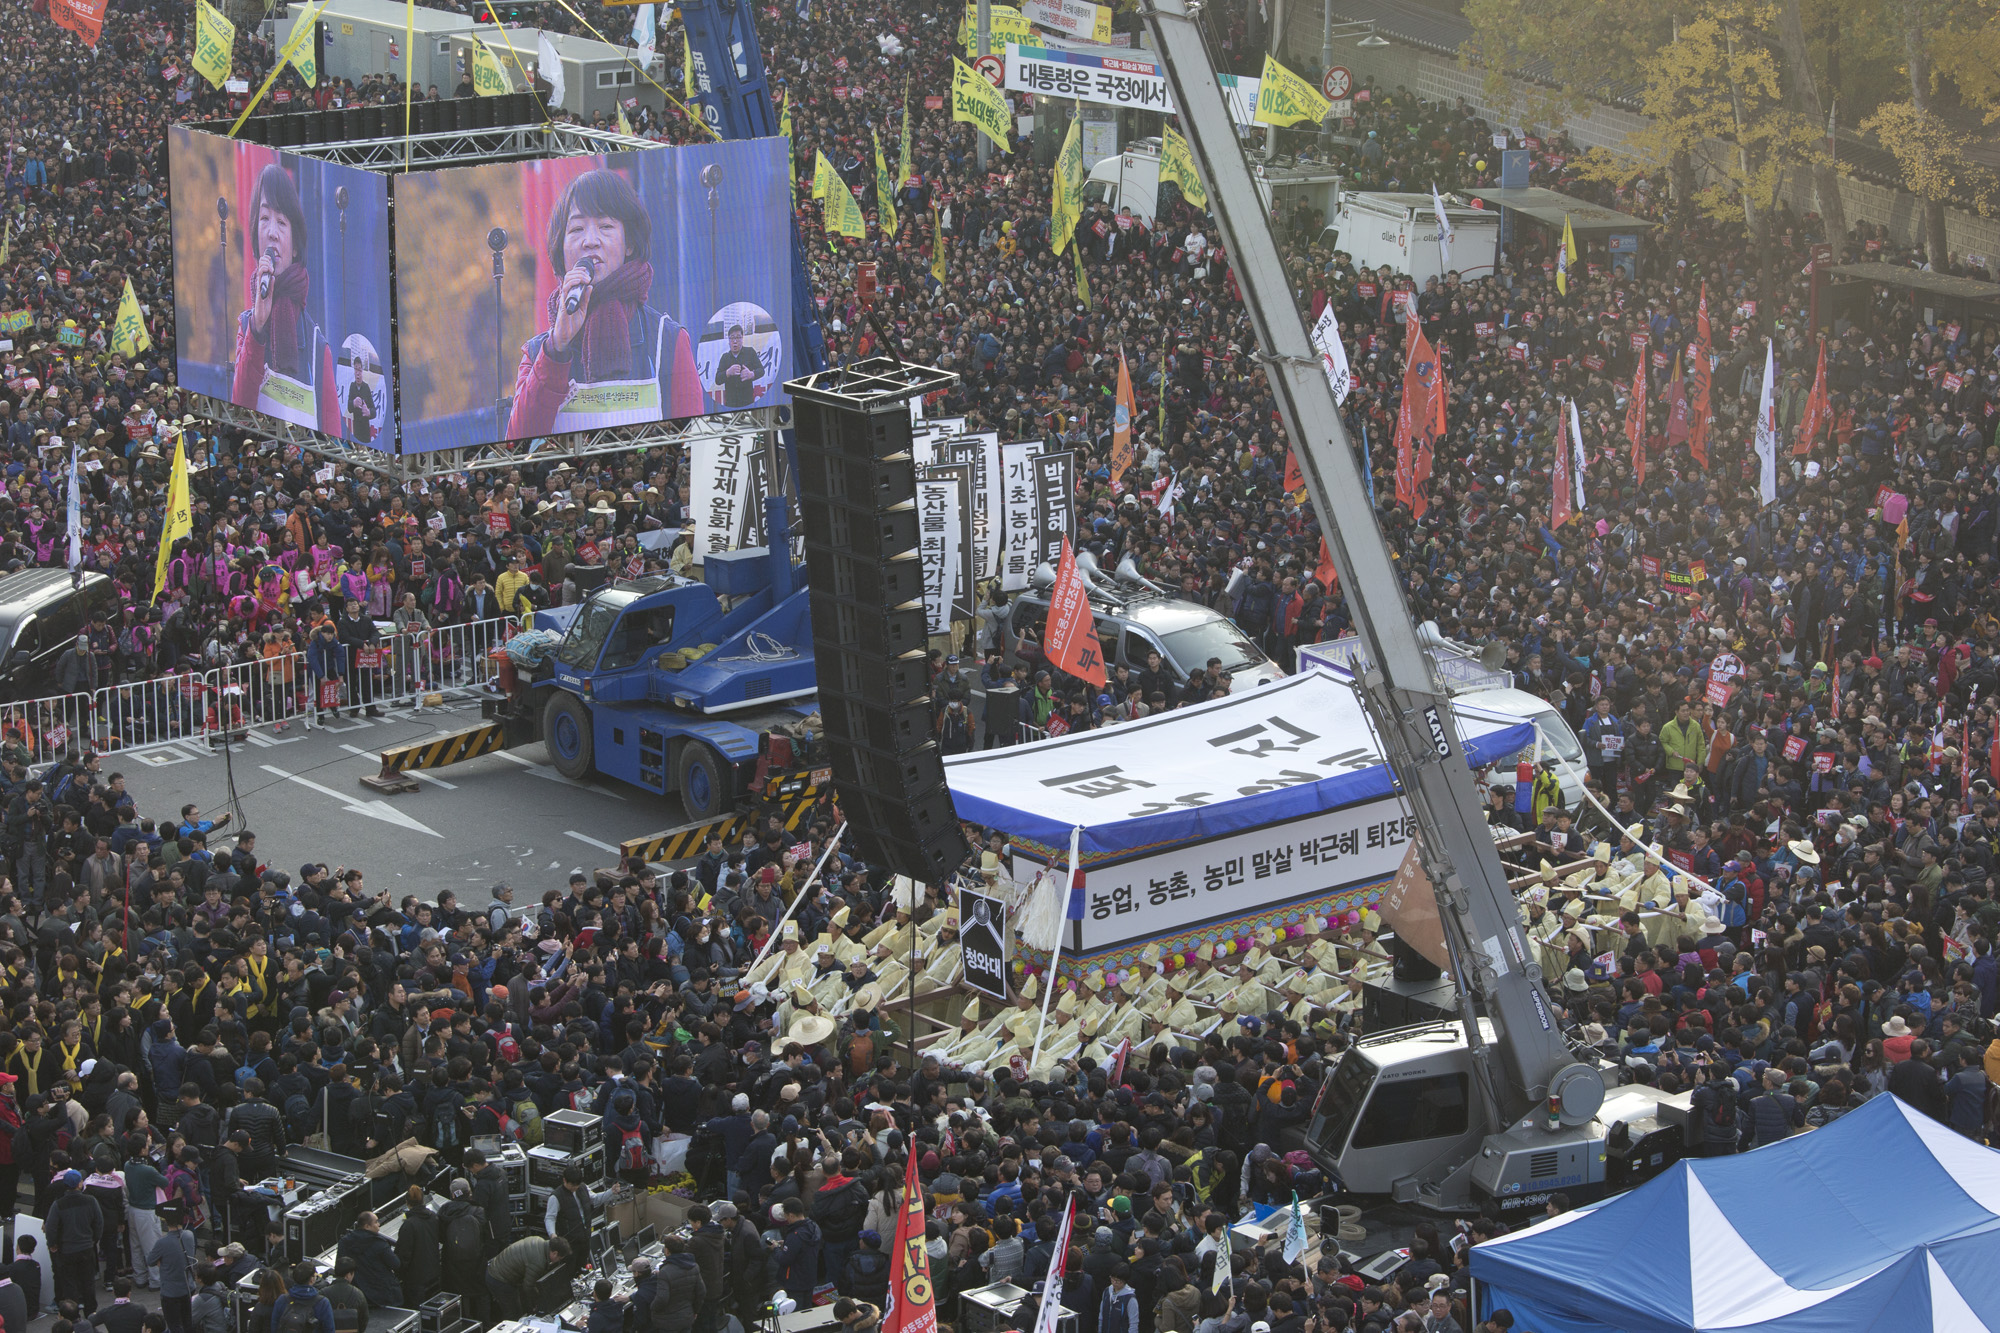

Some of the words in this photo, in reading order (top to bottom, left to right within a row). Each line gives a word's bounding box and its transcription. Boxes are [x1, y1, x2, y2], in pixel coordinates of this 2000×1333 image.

[1019, 63, 1091, 95] 대통령은
[1096, 73, 1167, 107] 국정에서
[1125, 157, 1134, 169] kt
[1382, 230, 1396, 243] olleh
[1424, 234, 1439, 242] olle
[57, 333, 86, 345] OUT!
[921, 485, 948, 532] 농산물
[1044, 461, 1068, 532] 박근혜
[707, 497, 736, 532] 완화
[922, 536, 946, 598] 최저가격
[925, 603, 942, 633] 인상
[1425, 708, 1449, 756] KATO
[1090, 886, 1140, 920] 농업,
[1146, 874, 1196, 908] 농촌,
[1203, 859, 1246, 892] 농민
[1252, 846, 1294, 881] 말살
[1299, 829, 1360, 868] 박근혜
[965, 946, 1001, 980] 청와대
[1531, 990, 1549, 1031] SUPERBOOM
[1402, 1069, 1427, 1077] WORKS
